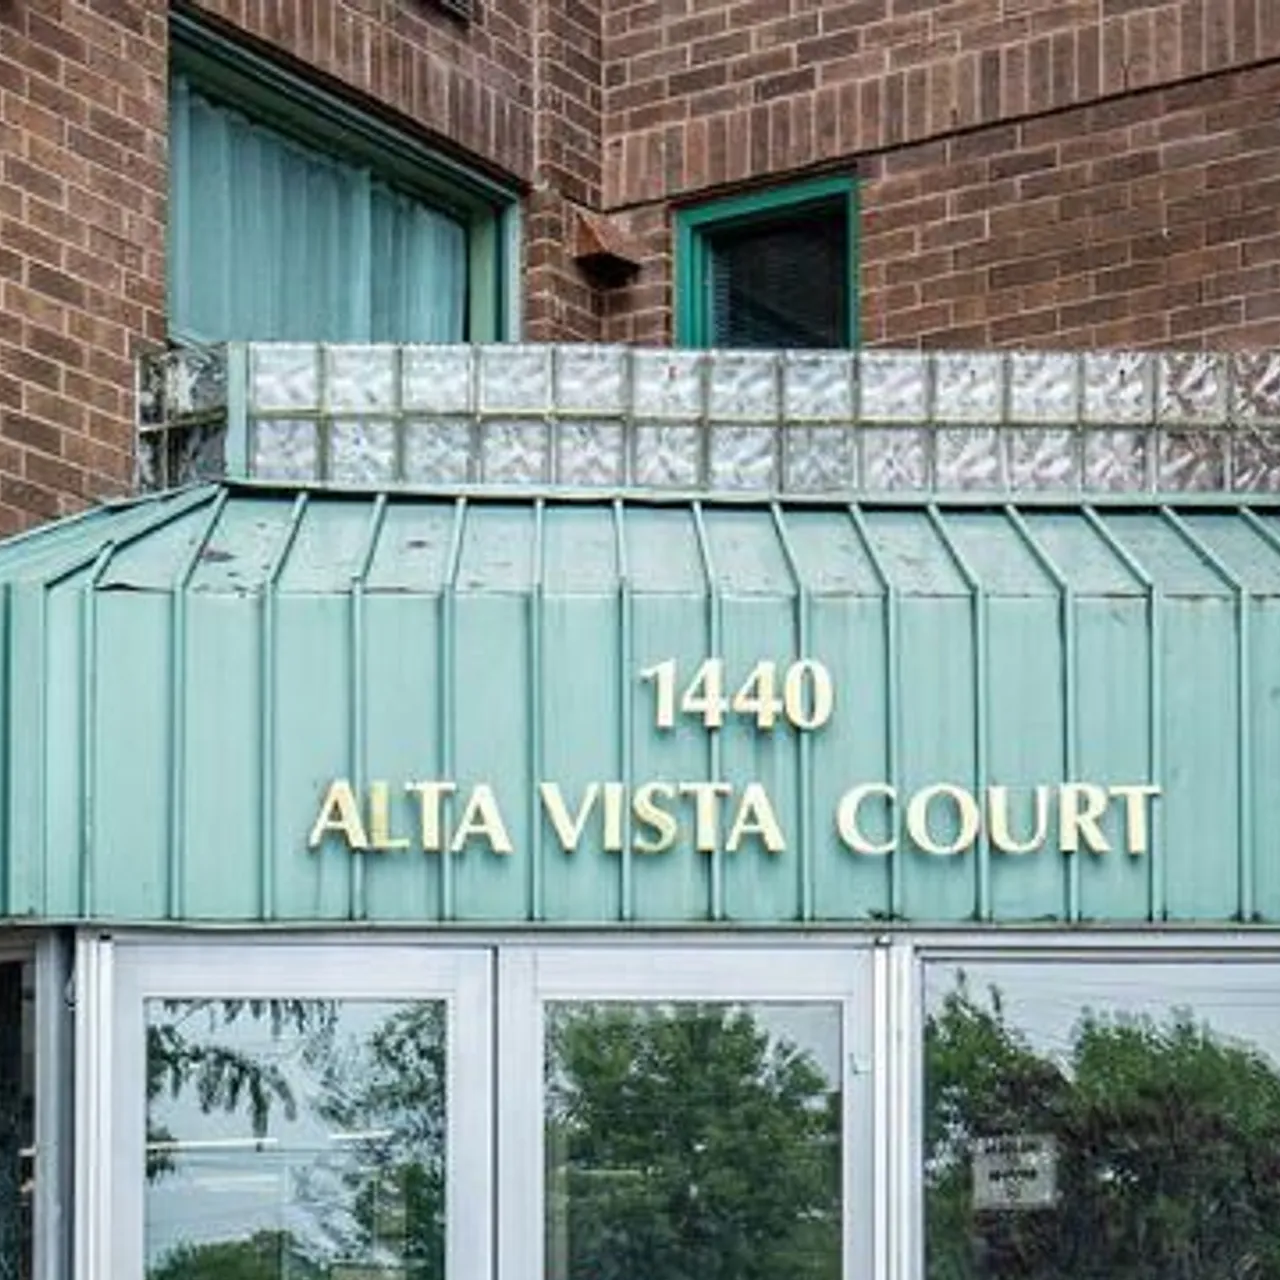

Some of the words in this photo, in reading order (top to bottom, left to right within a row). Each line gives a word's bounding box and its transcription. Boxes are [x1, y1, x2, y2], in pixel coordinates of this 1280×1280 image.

[638, 657, 834, 734] 1440
[308, 776, 514, 857] ALTA
[537, 778, 788, 857] VISTA
[835, 779, 1164, 858] COURT
